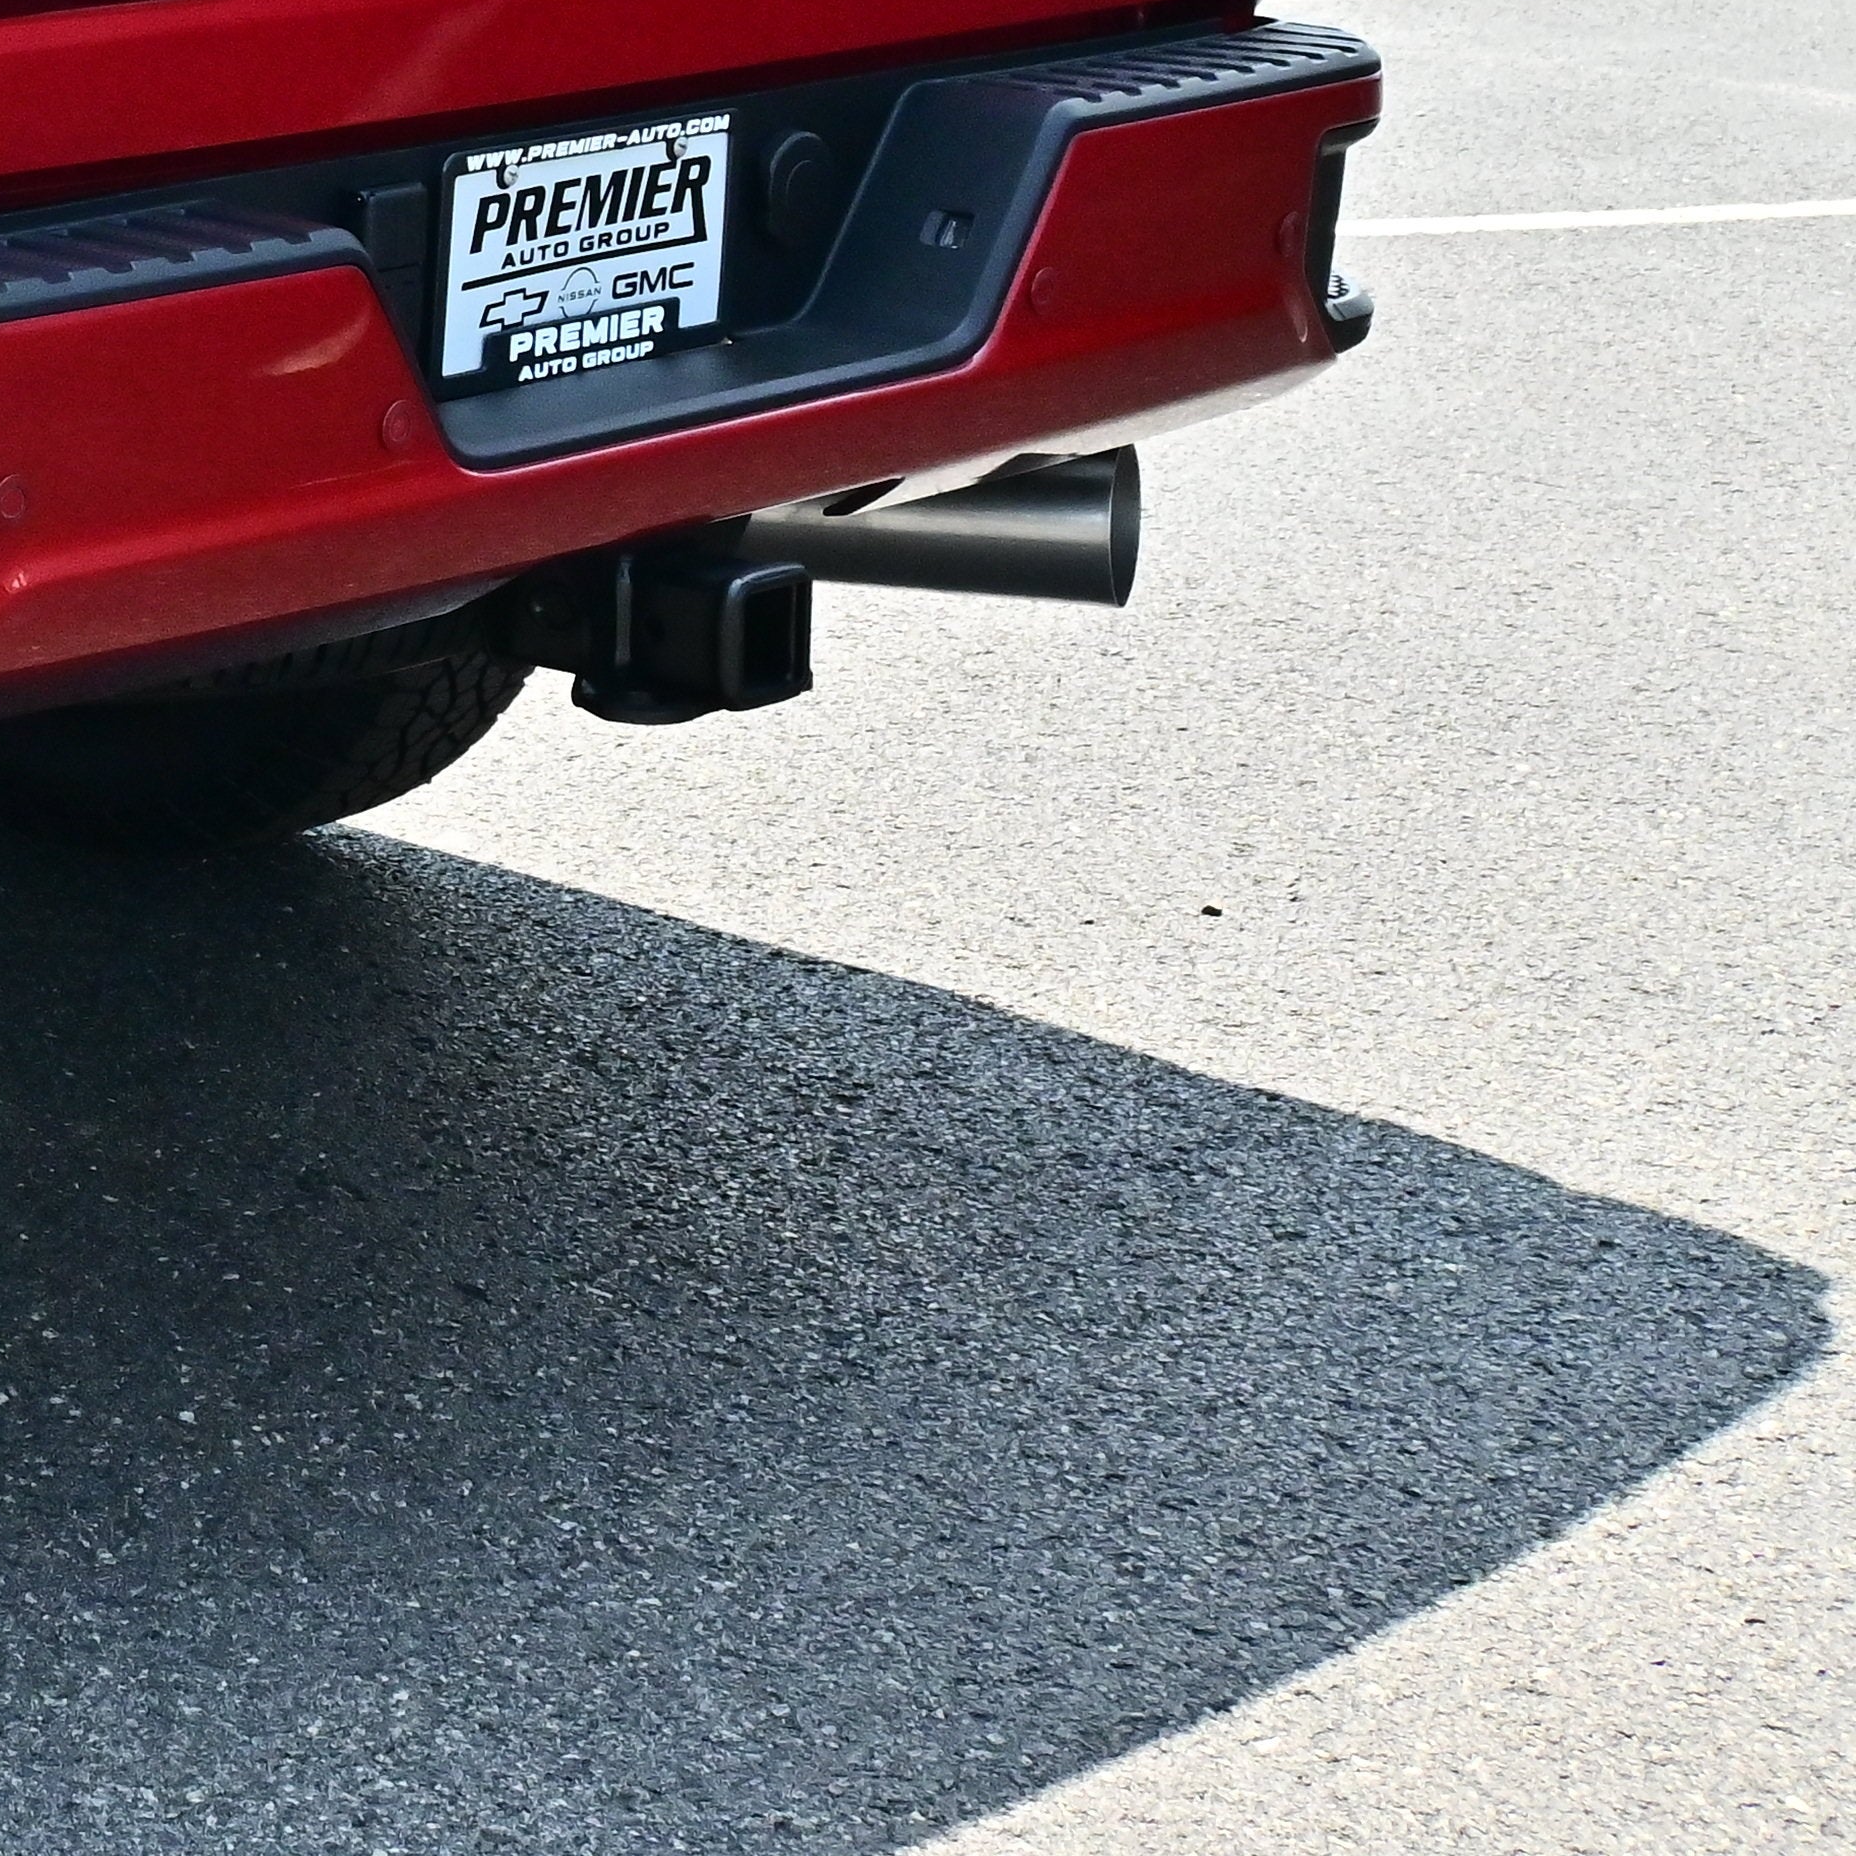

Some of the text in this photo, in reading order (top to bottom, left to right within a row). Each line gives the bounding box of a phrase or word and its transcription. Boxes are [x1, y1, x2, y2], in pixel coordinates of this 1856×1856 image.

[466, 113, 731, 173] WWW.PREMIER-AUTO.COM
[468, 154, 713, 256] PREMIER
[500, 221, 671, 272] AUTO GROUP
[556, 285, 603, 304] NISSAN
[611, 261, 696, 300] GMC
[508, 305, 666, 363] PREMIER
[517, 340, 655, 382] AUTO GROUP
